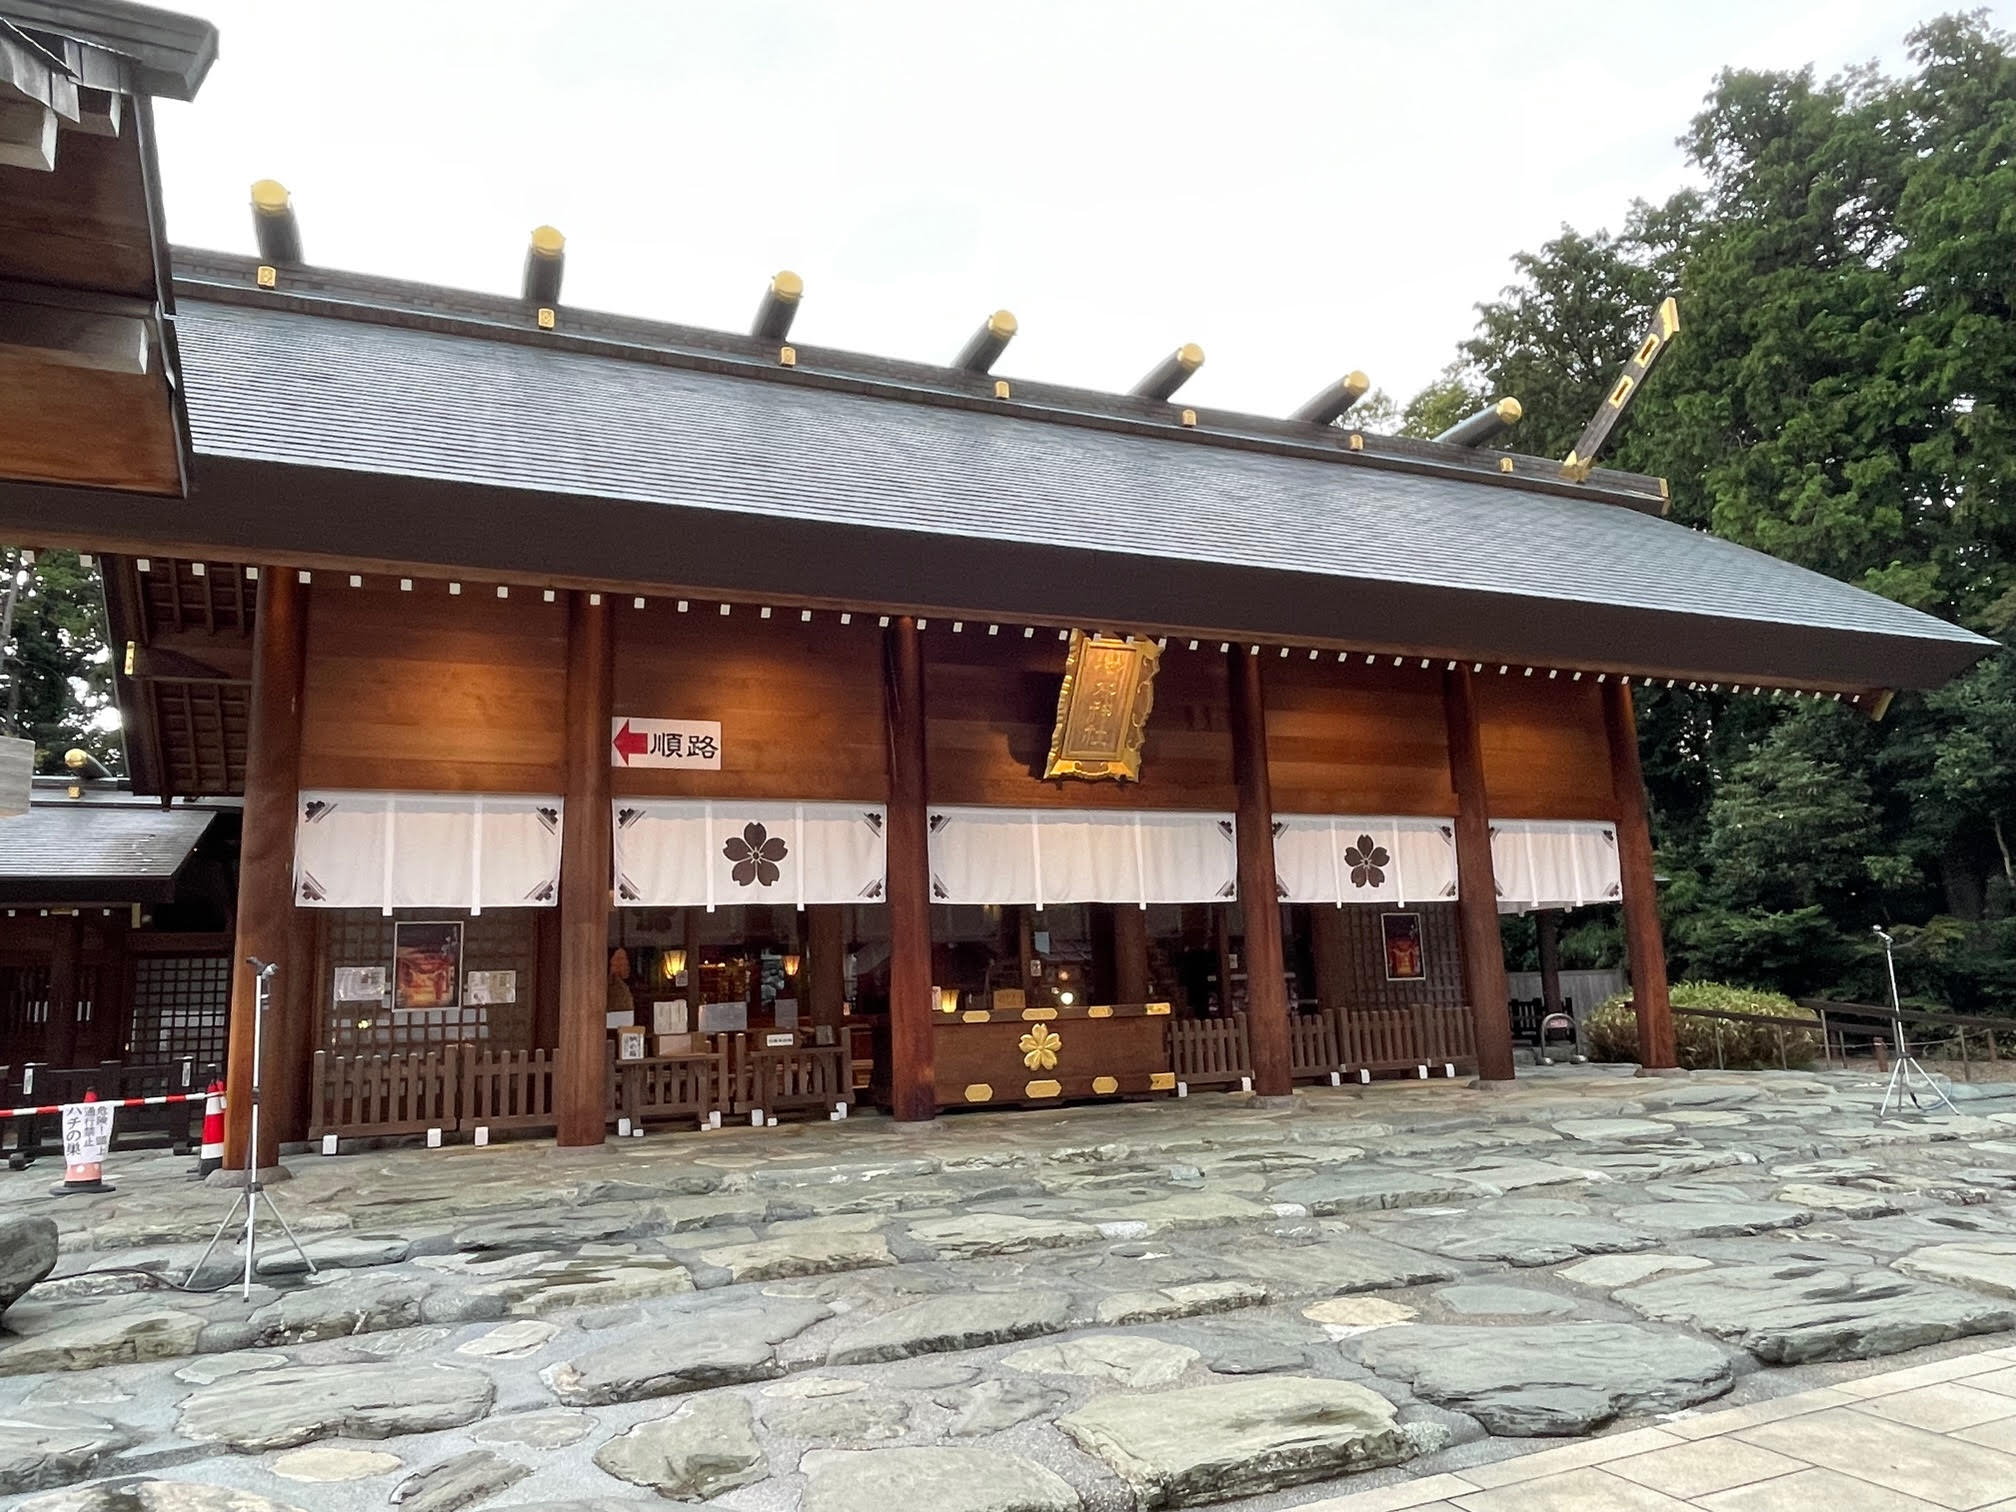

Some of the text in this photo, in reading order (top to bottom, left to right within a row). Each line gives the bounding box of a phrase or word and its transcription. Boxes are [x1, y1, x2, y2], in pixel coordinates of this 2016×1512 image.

[650, 732, 718, 759] 順路
[66, 1106, 82, 1156] ハチの巣
[83, 1106, 96, 1147] 通行禁止
